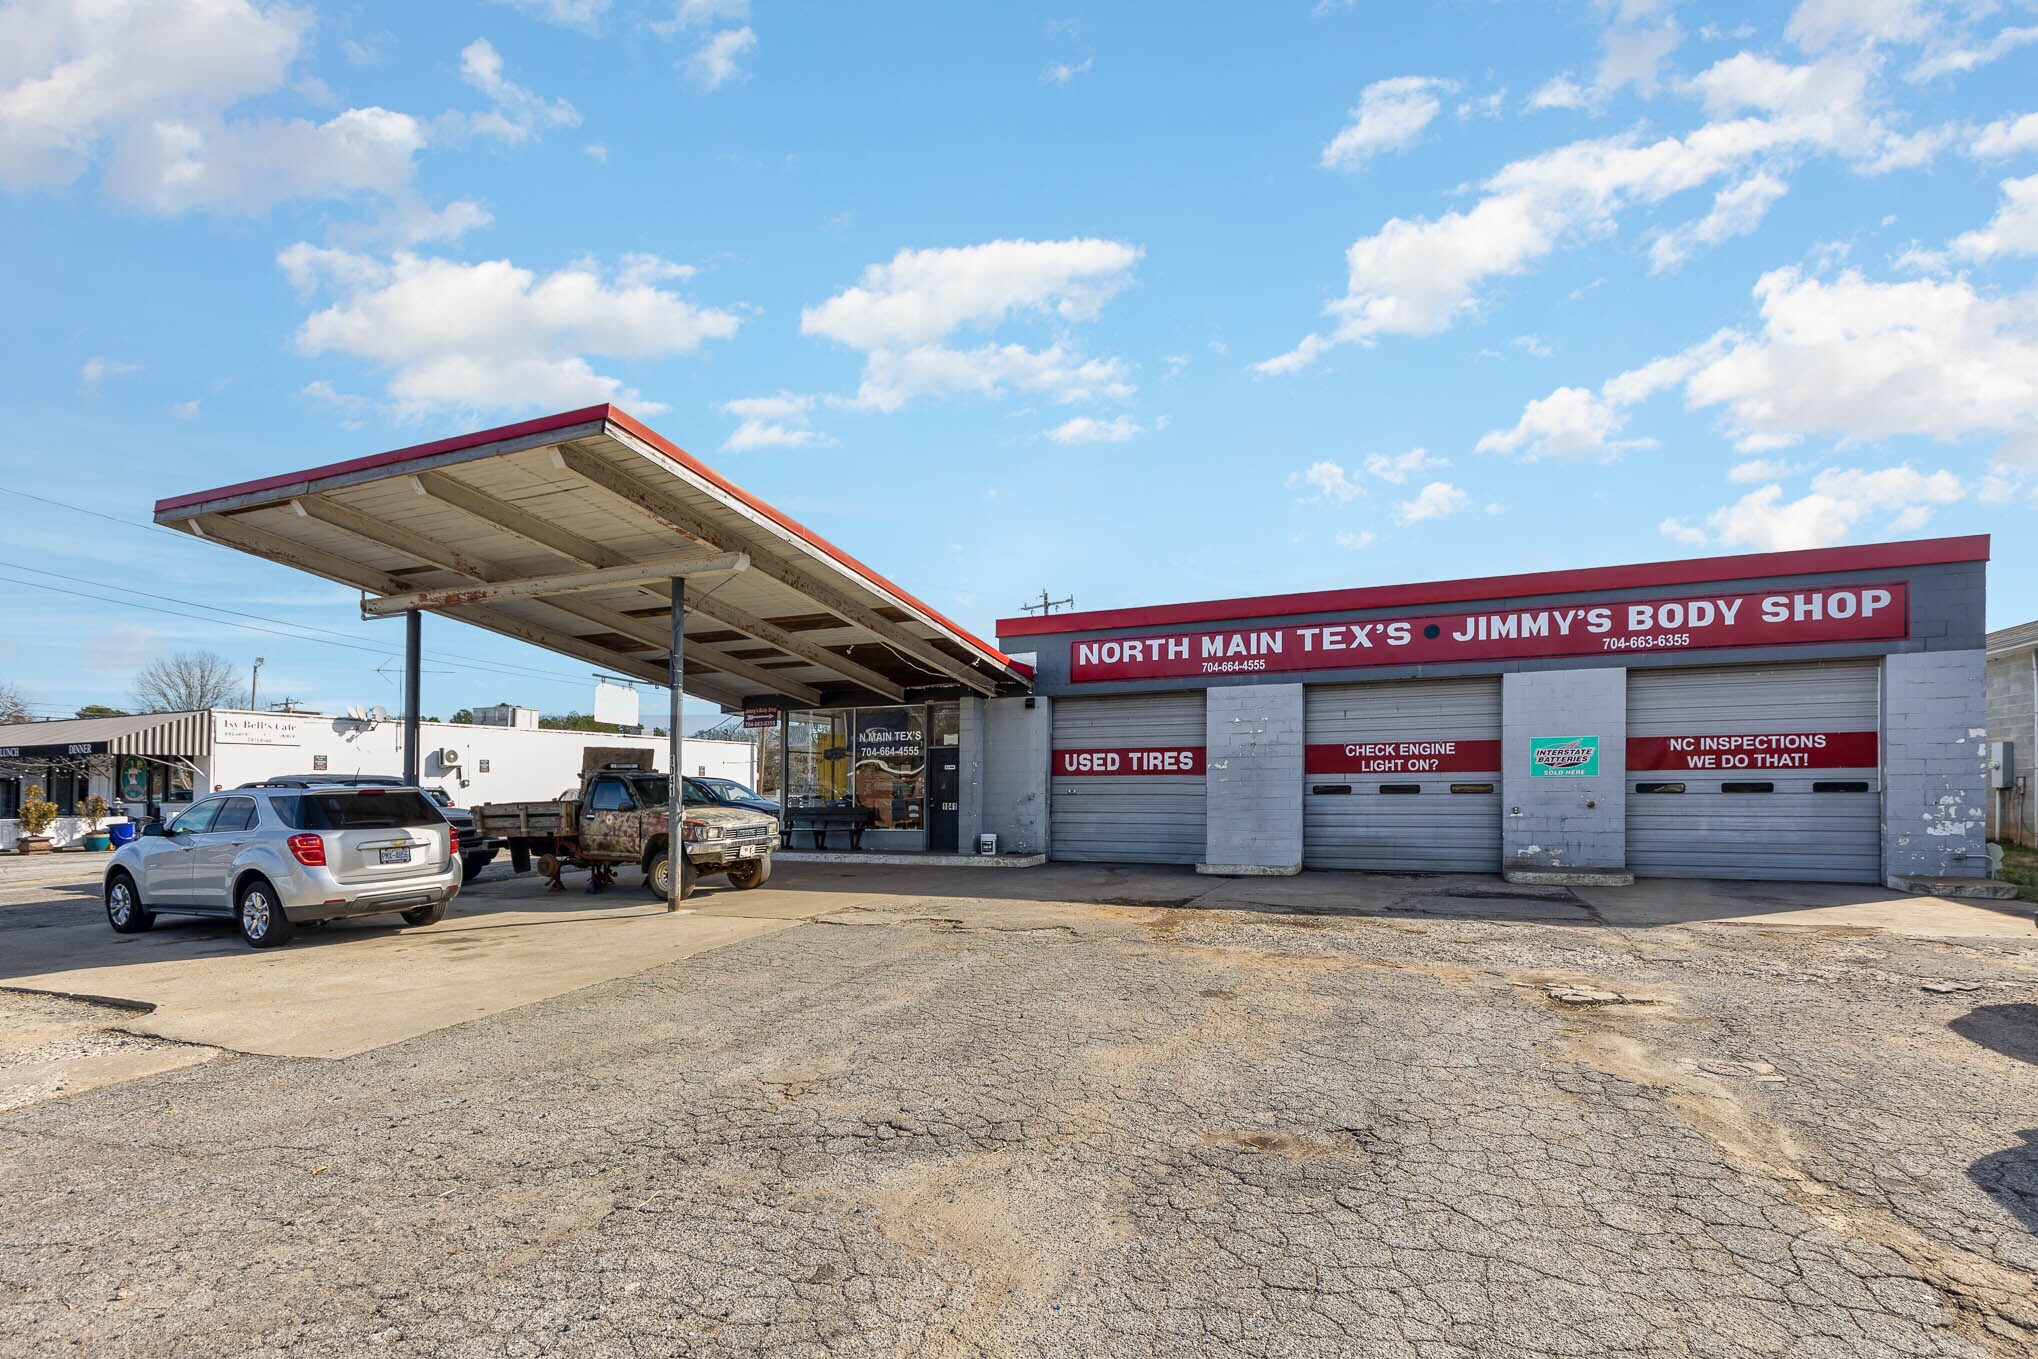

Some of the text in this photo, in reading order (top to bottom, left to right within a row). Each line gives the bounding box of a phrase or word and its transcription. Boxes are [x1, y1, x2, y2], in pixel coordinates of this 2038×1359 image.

[1452, 589, 1892, 642] JIMMY'S BODY SHOP
[1079, 622, 1412, 666] NORTH MAIN TEX'S
[1602, 634, 1690, 650] 704-663-6355
[1202, 659, 1266, 673] 704-664-4555
[868, 731, 892, 742] MAIN
[894, 730, 922, 741] TEX'S
[1669, 735, 1827, 751] NC INSPECTIONS
[68, 743, 92, 755] DINNER
[861, 746, 920, 757] 704-664-4555
[1345, 742, 1456, 757] CHECK ENGINE
[1536, 748, 1593, 756] INTERSTATE
[1064, 751, 1193, 772] USED TIRES
[1361, 758, 1439, 772] LIGHT ON?
[1537, 755, 1588, 763] BATTERIES
[1687, 753, 1809, 768] WE DO THAT!
